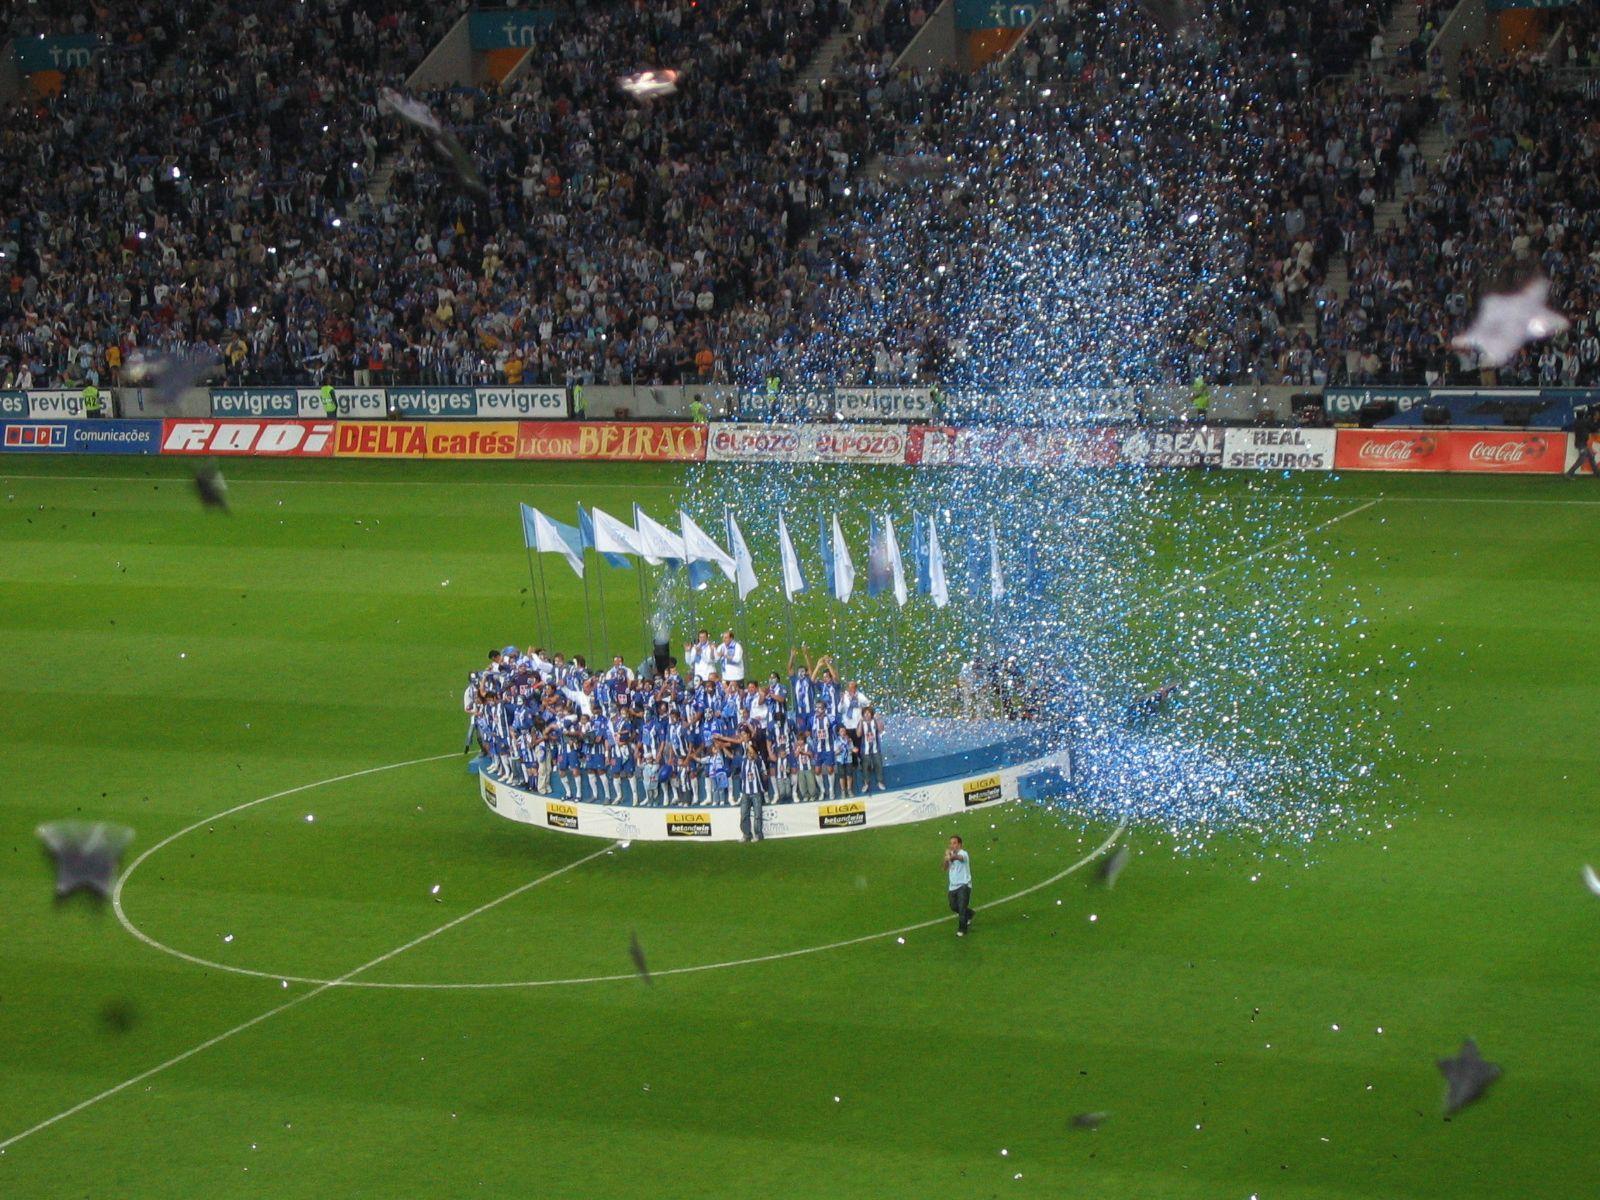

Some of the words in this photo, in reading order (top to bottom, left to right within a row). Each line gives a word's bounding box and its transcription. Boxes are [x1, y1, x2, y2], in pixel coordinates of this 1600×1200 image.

[0, 397, 22, 412] es
[31, 393, 107, 415] revigrs
[213, 391, 292, 414] revigres
[301, 393, 381, 413] regres
[390, 389, 471, 414] revigres
[479, 389, 561, 413] revigres
[837, 391, 925, 414] revigres
[74, 428, 150, 443] Comunicações
[337, 425, 428, 453] DELTA
[432, 431, 515, 454] cafés
[1155, 433, 1221, 453] REAL
[1253, 431, 1306, 446] REAL
[519, 438, 573, 455] LICOR
[1231, 453, 1324, 468] SEGUROS
[970, 778, 996, 790] LIGA
[551, 804, 574, 814] LIGA
[826, 804, 859, 815] LIGA
[673, 814, 705, 822] LIGA
